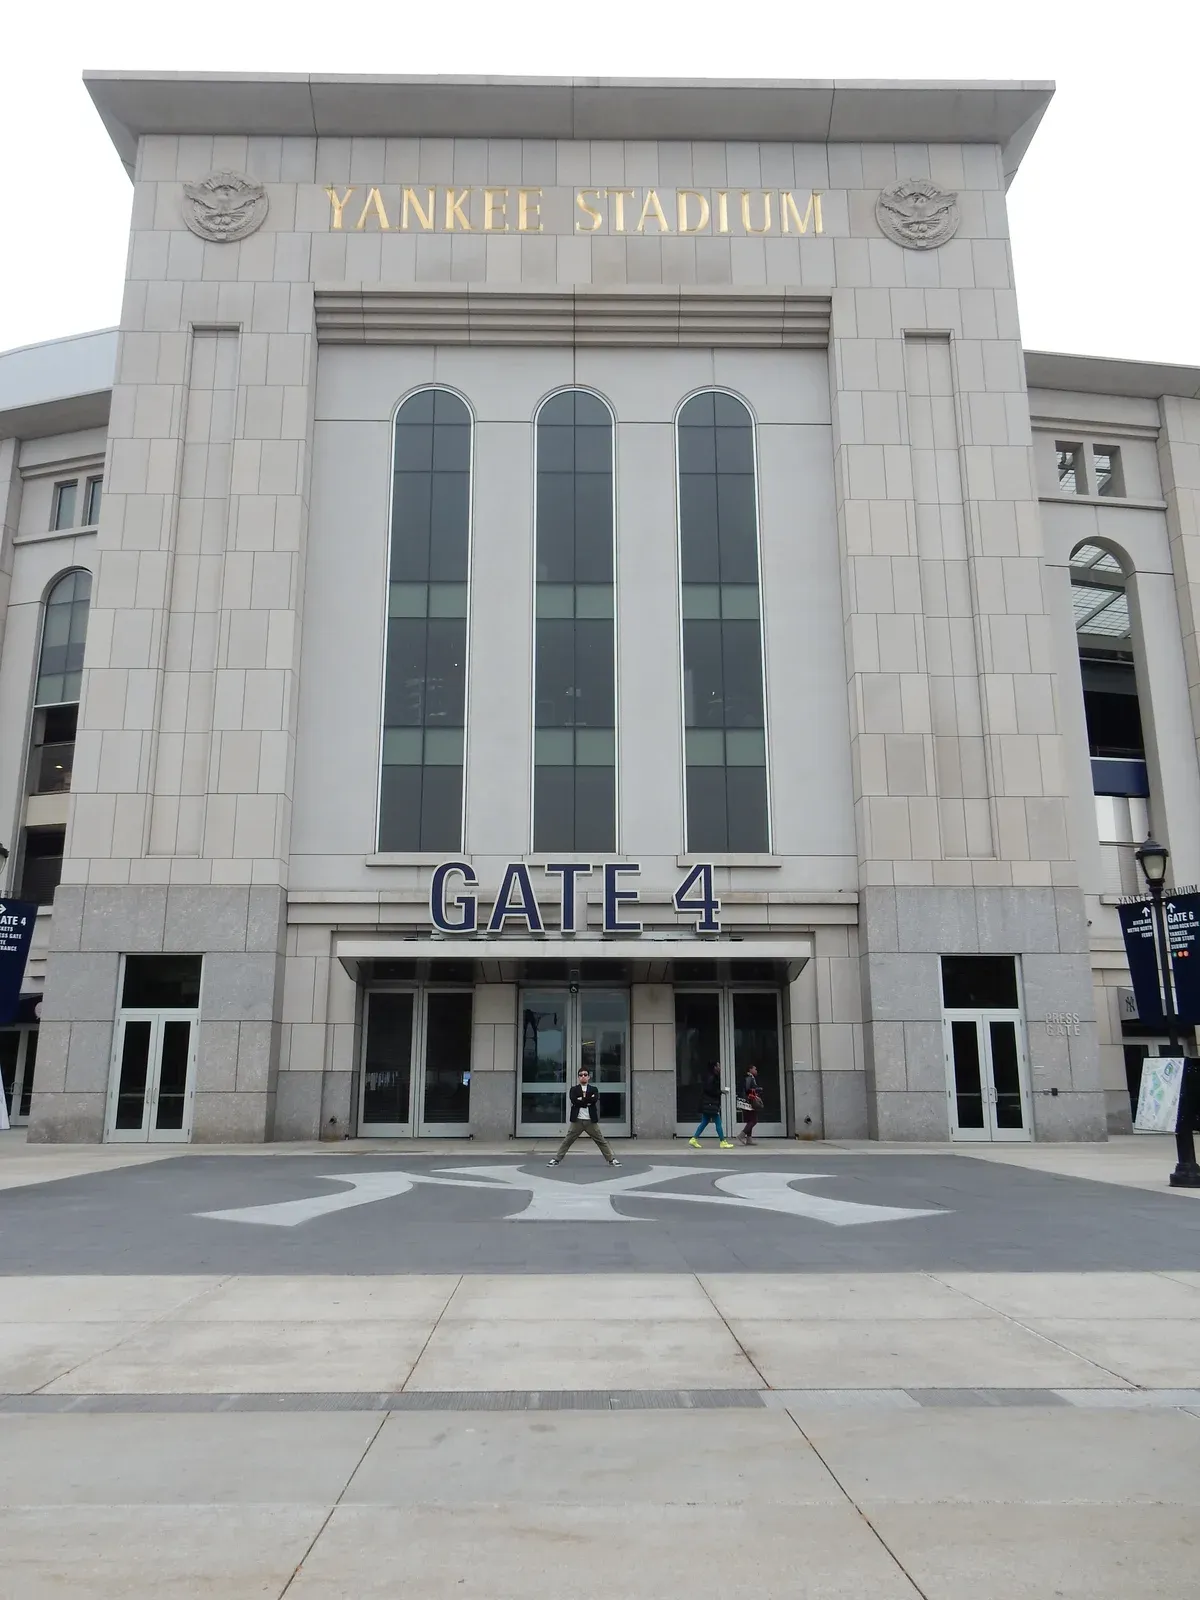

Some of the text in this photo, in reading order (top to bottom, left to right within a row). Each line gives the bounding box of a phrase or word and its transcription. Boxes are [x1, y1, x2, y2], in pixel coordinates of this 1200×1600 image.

[323, 186, 826, 234] YANKEE STADIUM
[1165, 884, 1198, 897] STADIUM
[429, 861, 721, 935] GATE 4
[0, 916, 27, 926] ATE 4
[1168, 911, 1194, 923] GATE 6
[1045, 1012, 1080, 1024] PRESS
[1046, 1024, 1080, 1036] GATE
